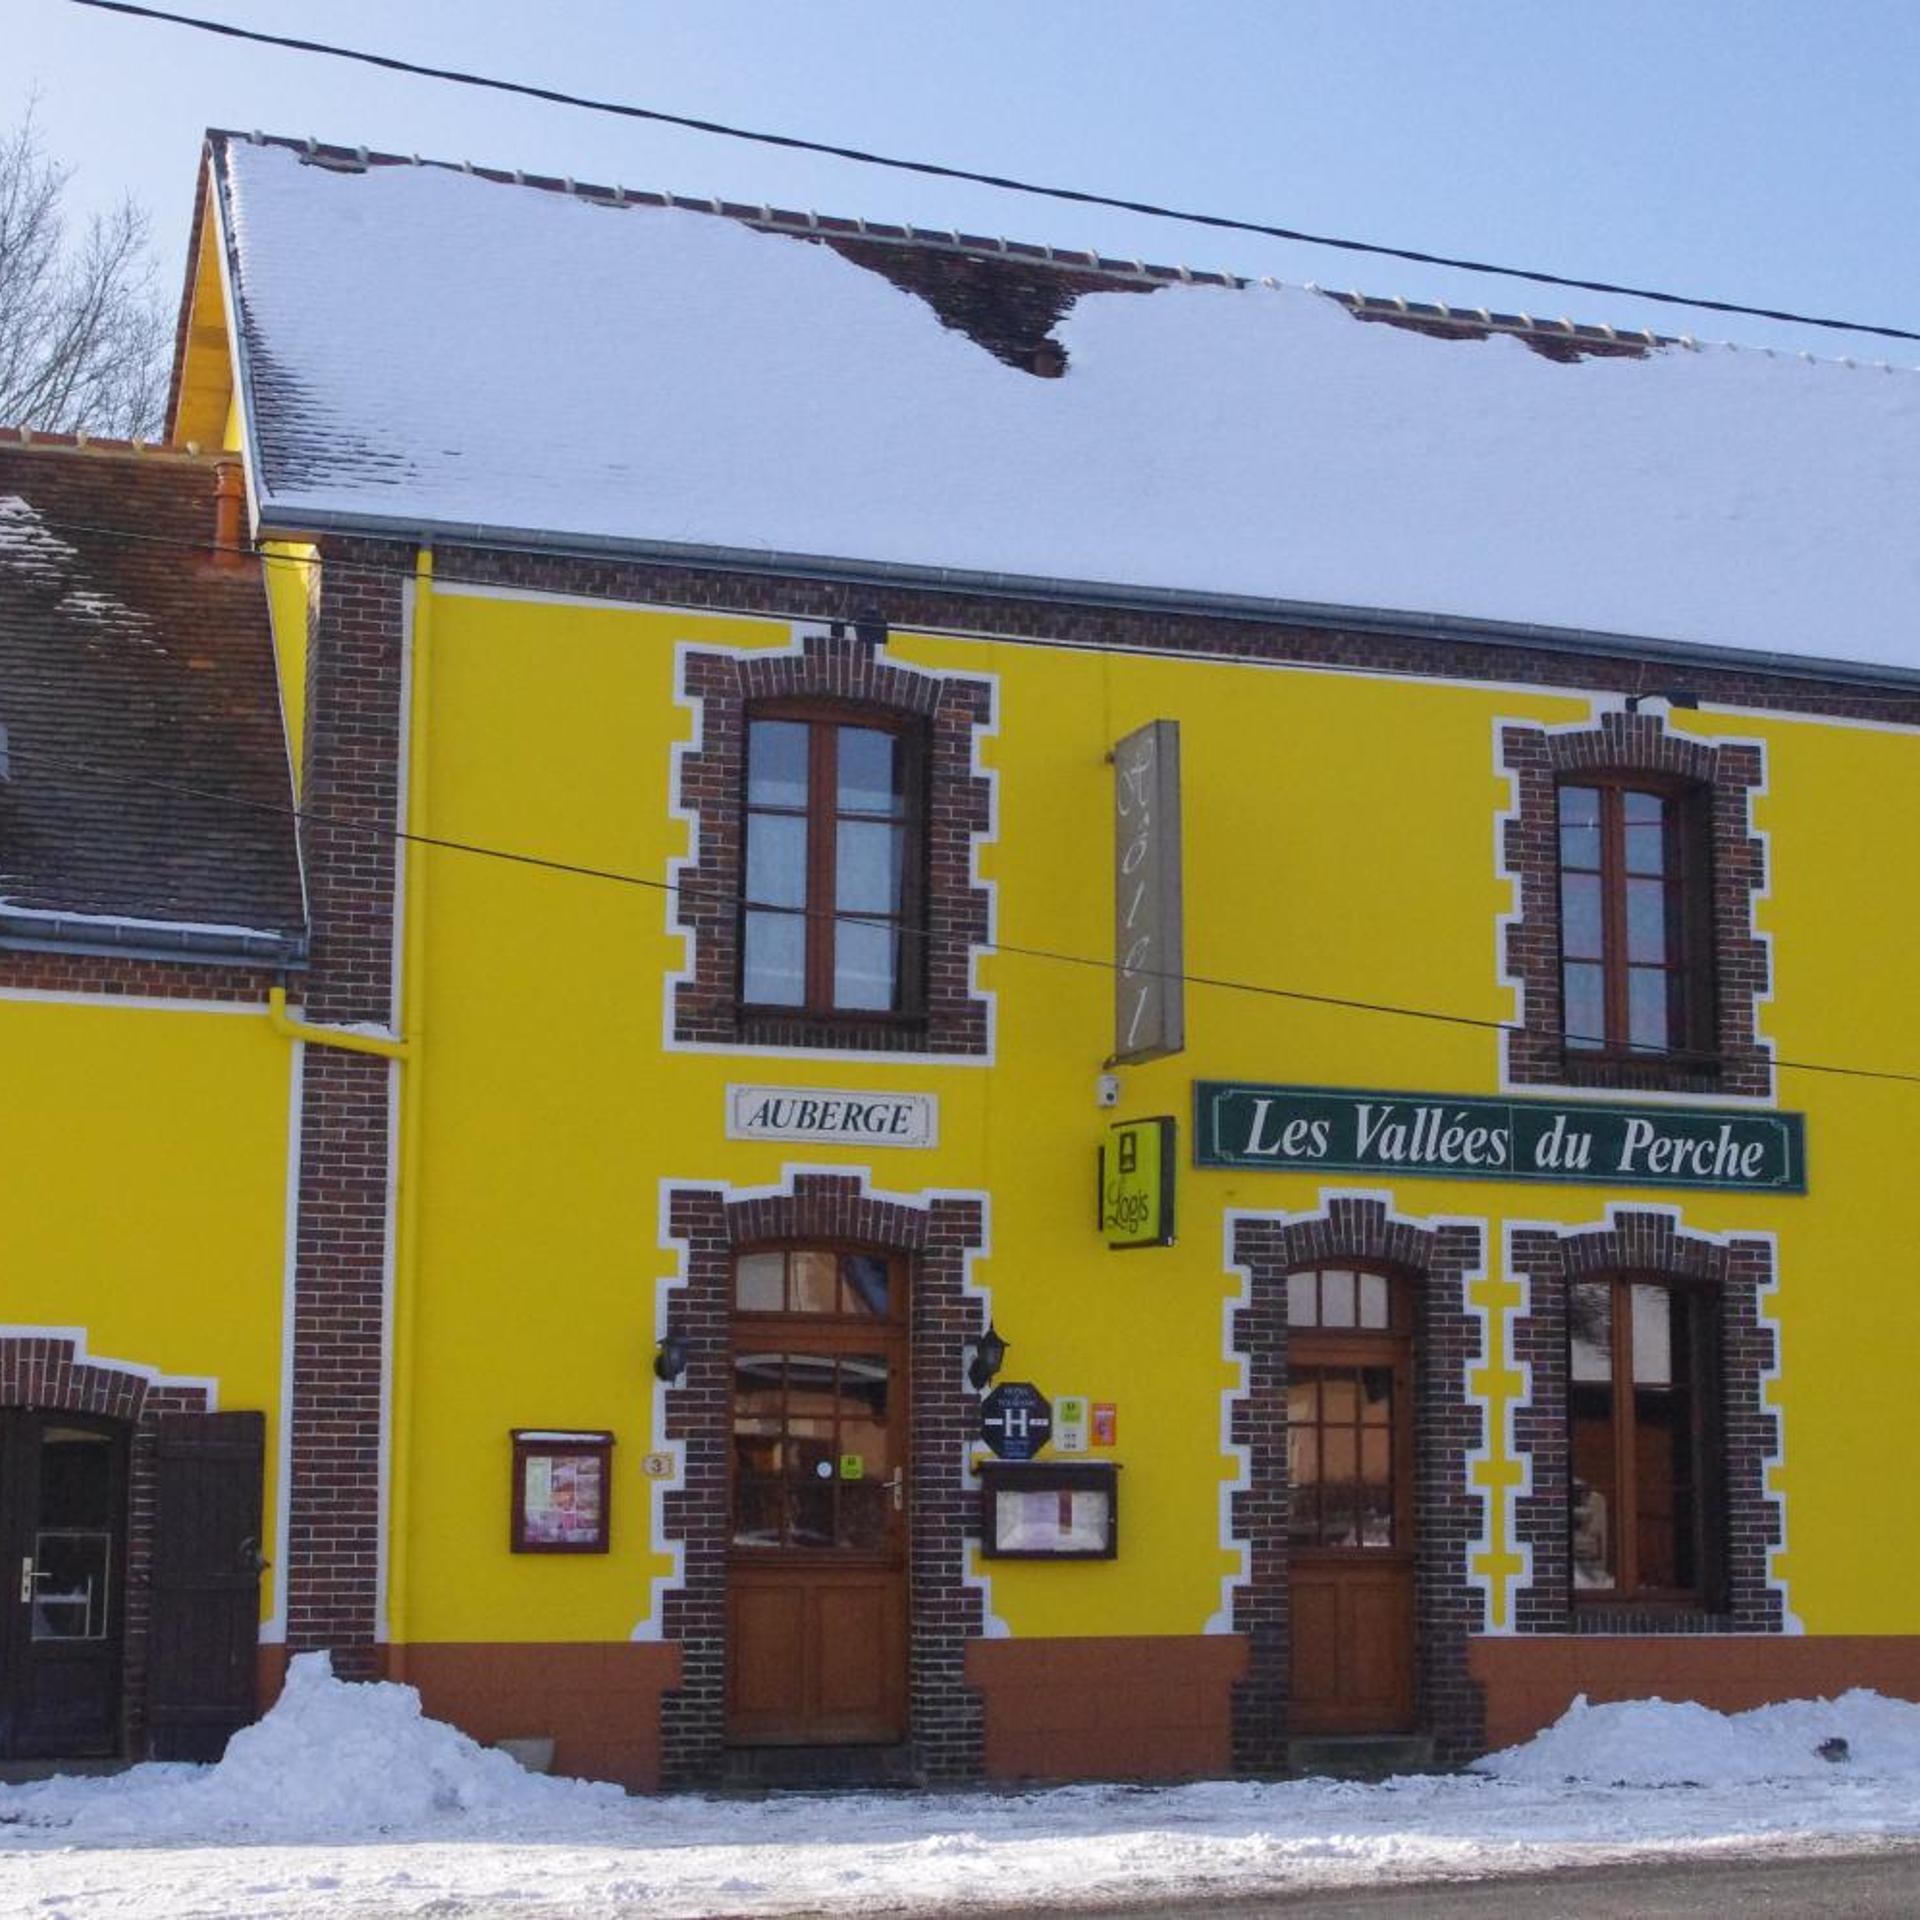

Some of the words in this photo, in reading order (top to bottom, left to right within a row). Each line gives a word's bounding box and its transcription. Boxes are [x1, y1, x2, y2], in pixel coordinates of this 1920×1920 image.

[748, 1098, 913, 1134] AUBERGE
[1244, 1099, 1330, 1158] Les
[1354, 1103, 1509, 1166] Vallées
[1535, 1115, 1592, 1169] du
[1616, 1117, 1765, 1177] Perche
[1106, 1178, 1149, 1233] Logis
[1004, 1408, 1028, 1438] H
